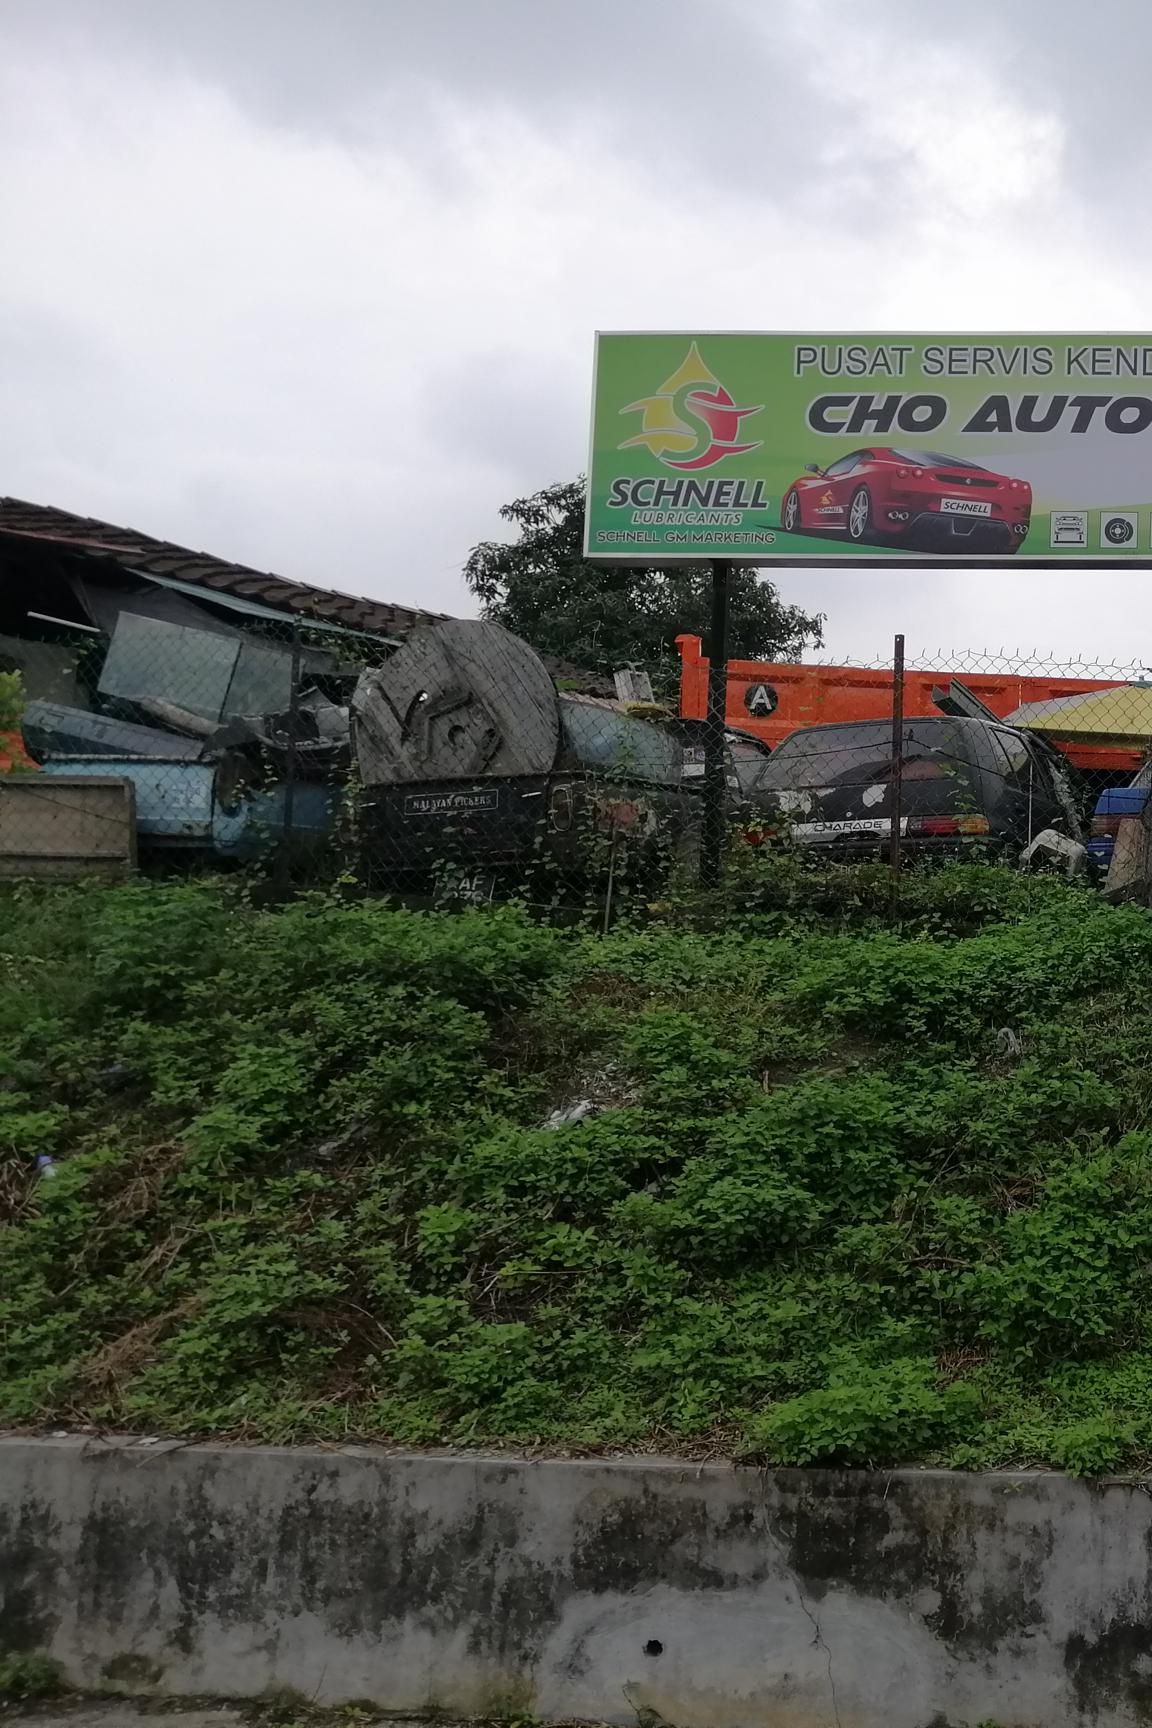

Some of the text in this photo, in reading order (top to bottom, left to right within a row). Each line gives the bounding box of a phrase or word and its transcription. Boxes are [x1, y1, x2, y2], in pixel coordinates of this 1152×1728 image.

[795, 346, 913, 376] PUSAT
[922, 346, 1054, 376] SERVIS
[808, 394, 948, 434] CHO
[608, 478, 769, 509] SCHNELL
[943, 500, 990, 514] SCHNELL
[632, 512, 743, 525] LUBRICANTS
[597, 531, 776, 544] SCHNELL GM MARKETING
[750, 685, 773, 710] A
[813, 820, 883, 833] CHARADE
